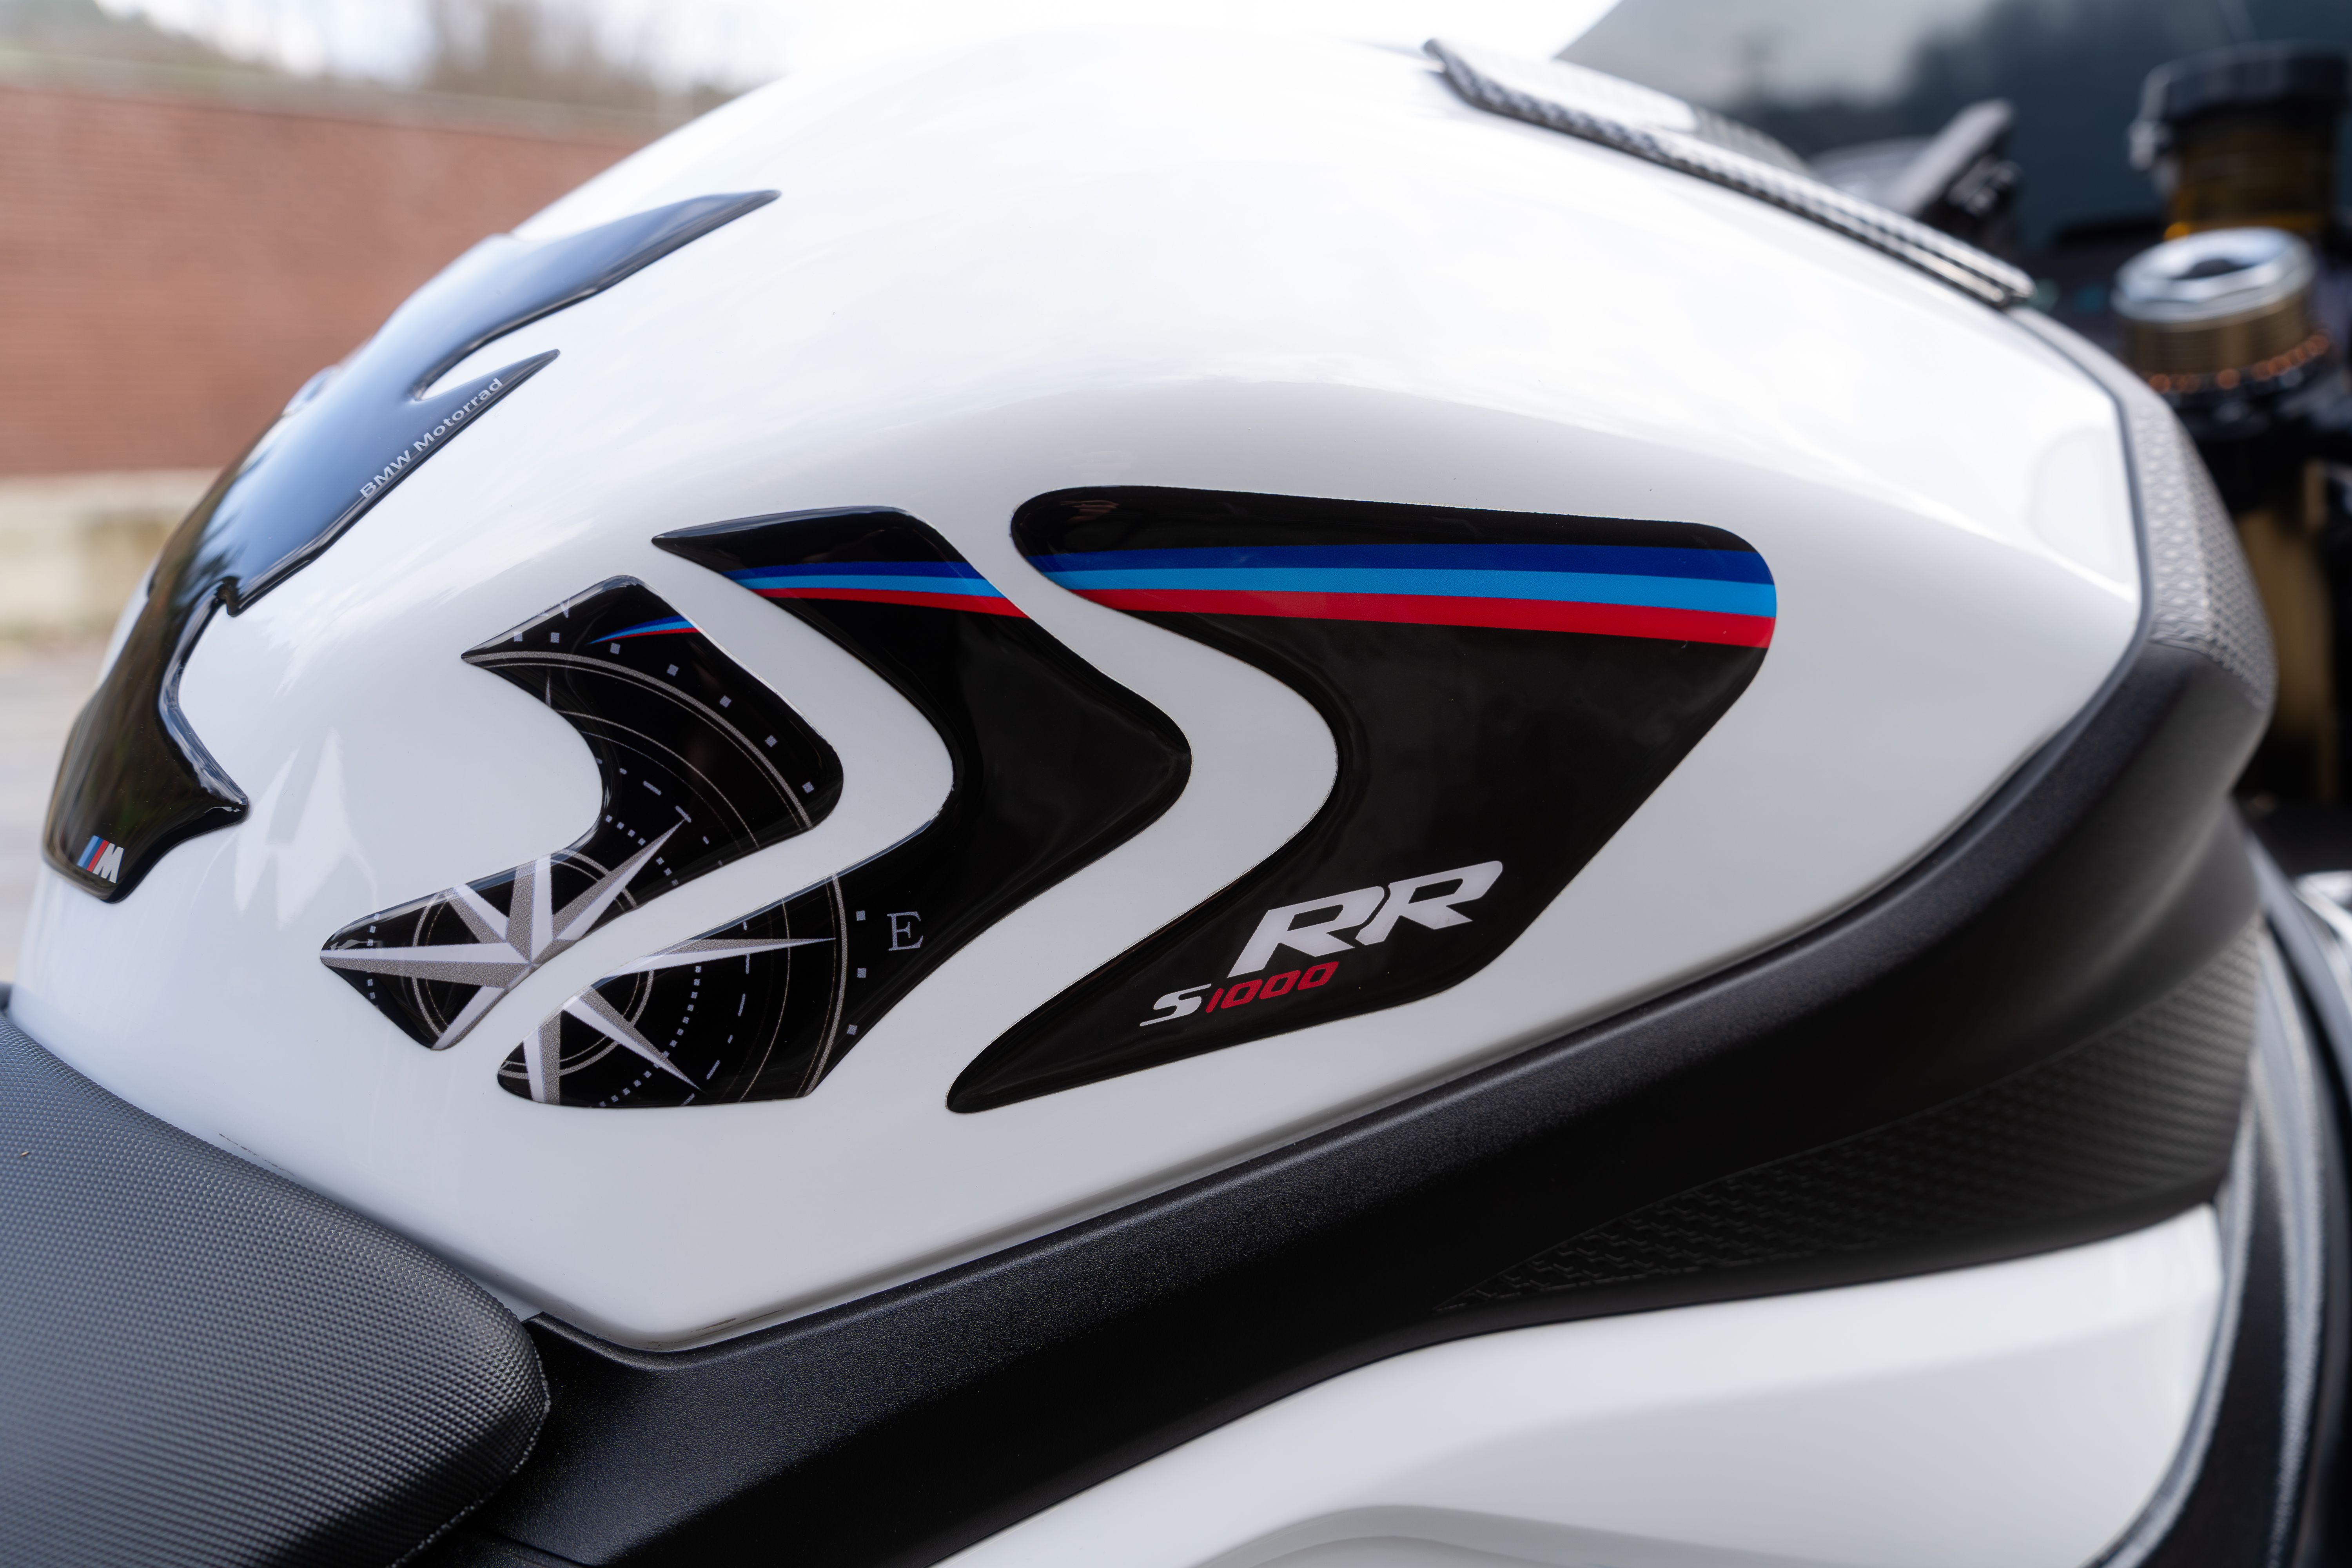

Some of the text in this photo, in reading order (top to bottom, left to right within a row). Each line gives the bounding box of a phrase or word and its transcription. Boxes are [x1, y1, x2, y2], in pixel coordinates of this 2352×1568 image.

[359, 378, 503, 498] BMW Motorrad
[93, 843, 124, 883] M
[887, 911, 923, 951] E
[1227, 860, 1503, 978] RR
